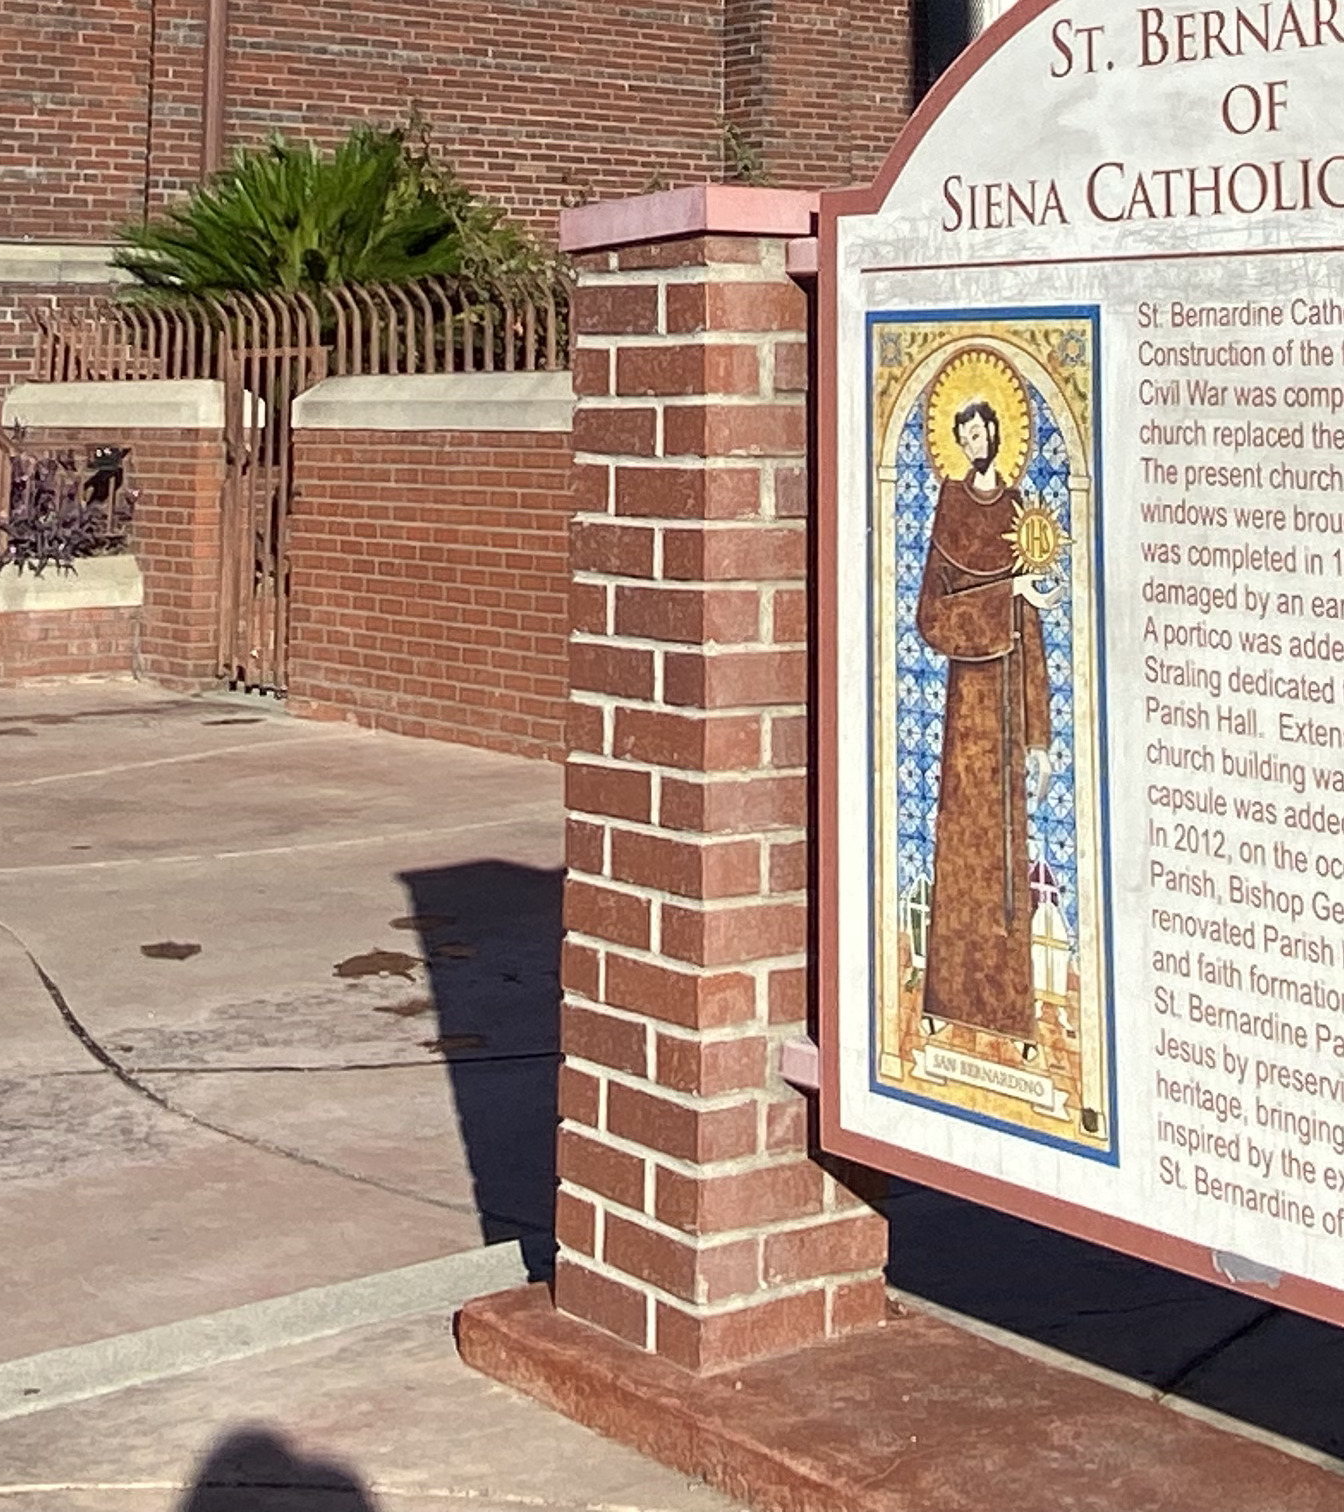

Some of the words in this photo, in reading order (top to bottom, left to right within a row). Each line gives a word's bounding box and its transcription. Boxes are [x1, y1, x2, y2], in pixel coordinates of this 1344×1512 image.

[1050, 18, 1115, 79] ST.
[1222, 80, 1288, 135] OF
[942, 174, 1071, 232] SIENA
[1138, 302, 1163, 328] St.
[1171, 301, 1283, 328] Bernardine
[1139, 340, 1265, 367] Construction
[1272, 339, 1294, 366] of
[1300, 339, 1334, 366] the
[1139, 419, 1206, 446] church
[1213, 421, 1304, 453] replaced
[1140, 457, 1178, 485] The
[1185, 462, 1263, 492] present
[1269, 462, 1344, 491] church
[1141, 497, 1227, 527] windows
[1234, 508, 1286, 531] were
[1142, 576, 1237, 615] damaged
[1244, 584, 1270, 620] by
[1277, 593, 1304, 616] an
[1145, 655, 1221, 698] Straling
[1228, 666, 1335, 704] dedicated
[1146, 696, 1210, 730] Parish
[1217, 705, 1263, 738] Hall.
[1147, 738, 1214, 772] church
[1222, 747, 1306, 794] building
[1148, 785, 1227, 816] capsule
[1234, 798, 1277, 825] was
[1151, 860, 1222, 905] Parish,
[1229, 875, 1304, 923] Bishop
[1152, 909, 1255, 950] renovated
[1264, 924, 1334, 967] Parish
[1153, 950, 1191, 978] and
[1197, 952, 1242, 990] faith
[1154, 985, 1182, 1018] St.
[1189, 993, 1307, 1048] Bernardine
[1155, 1028, 1216, 1069] Jesus
[1223, 1044, 1248, 1085] by
[1157, 1070, 1248, 1125] heritage,
[1158, 1113, 1240, 1162] inspired
[1248, 1137, 1273, 1178] by
[1281, 1149, 1316, 1184] the
[1160, 1156, 1187, 1189] St.
[1195, 1165, 1314, 1228] Bernardine
[1322, 1208, 1344, 1237] of
